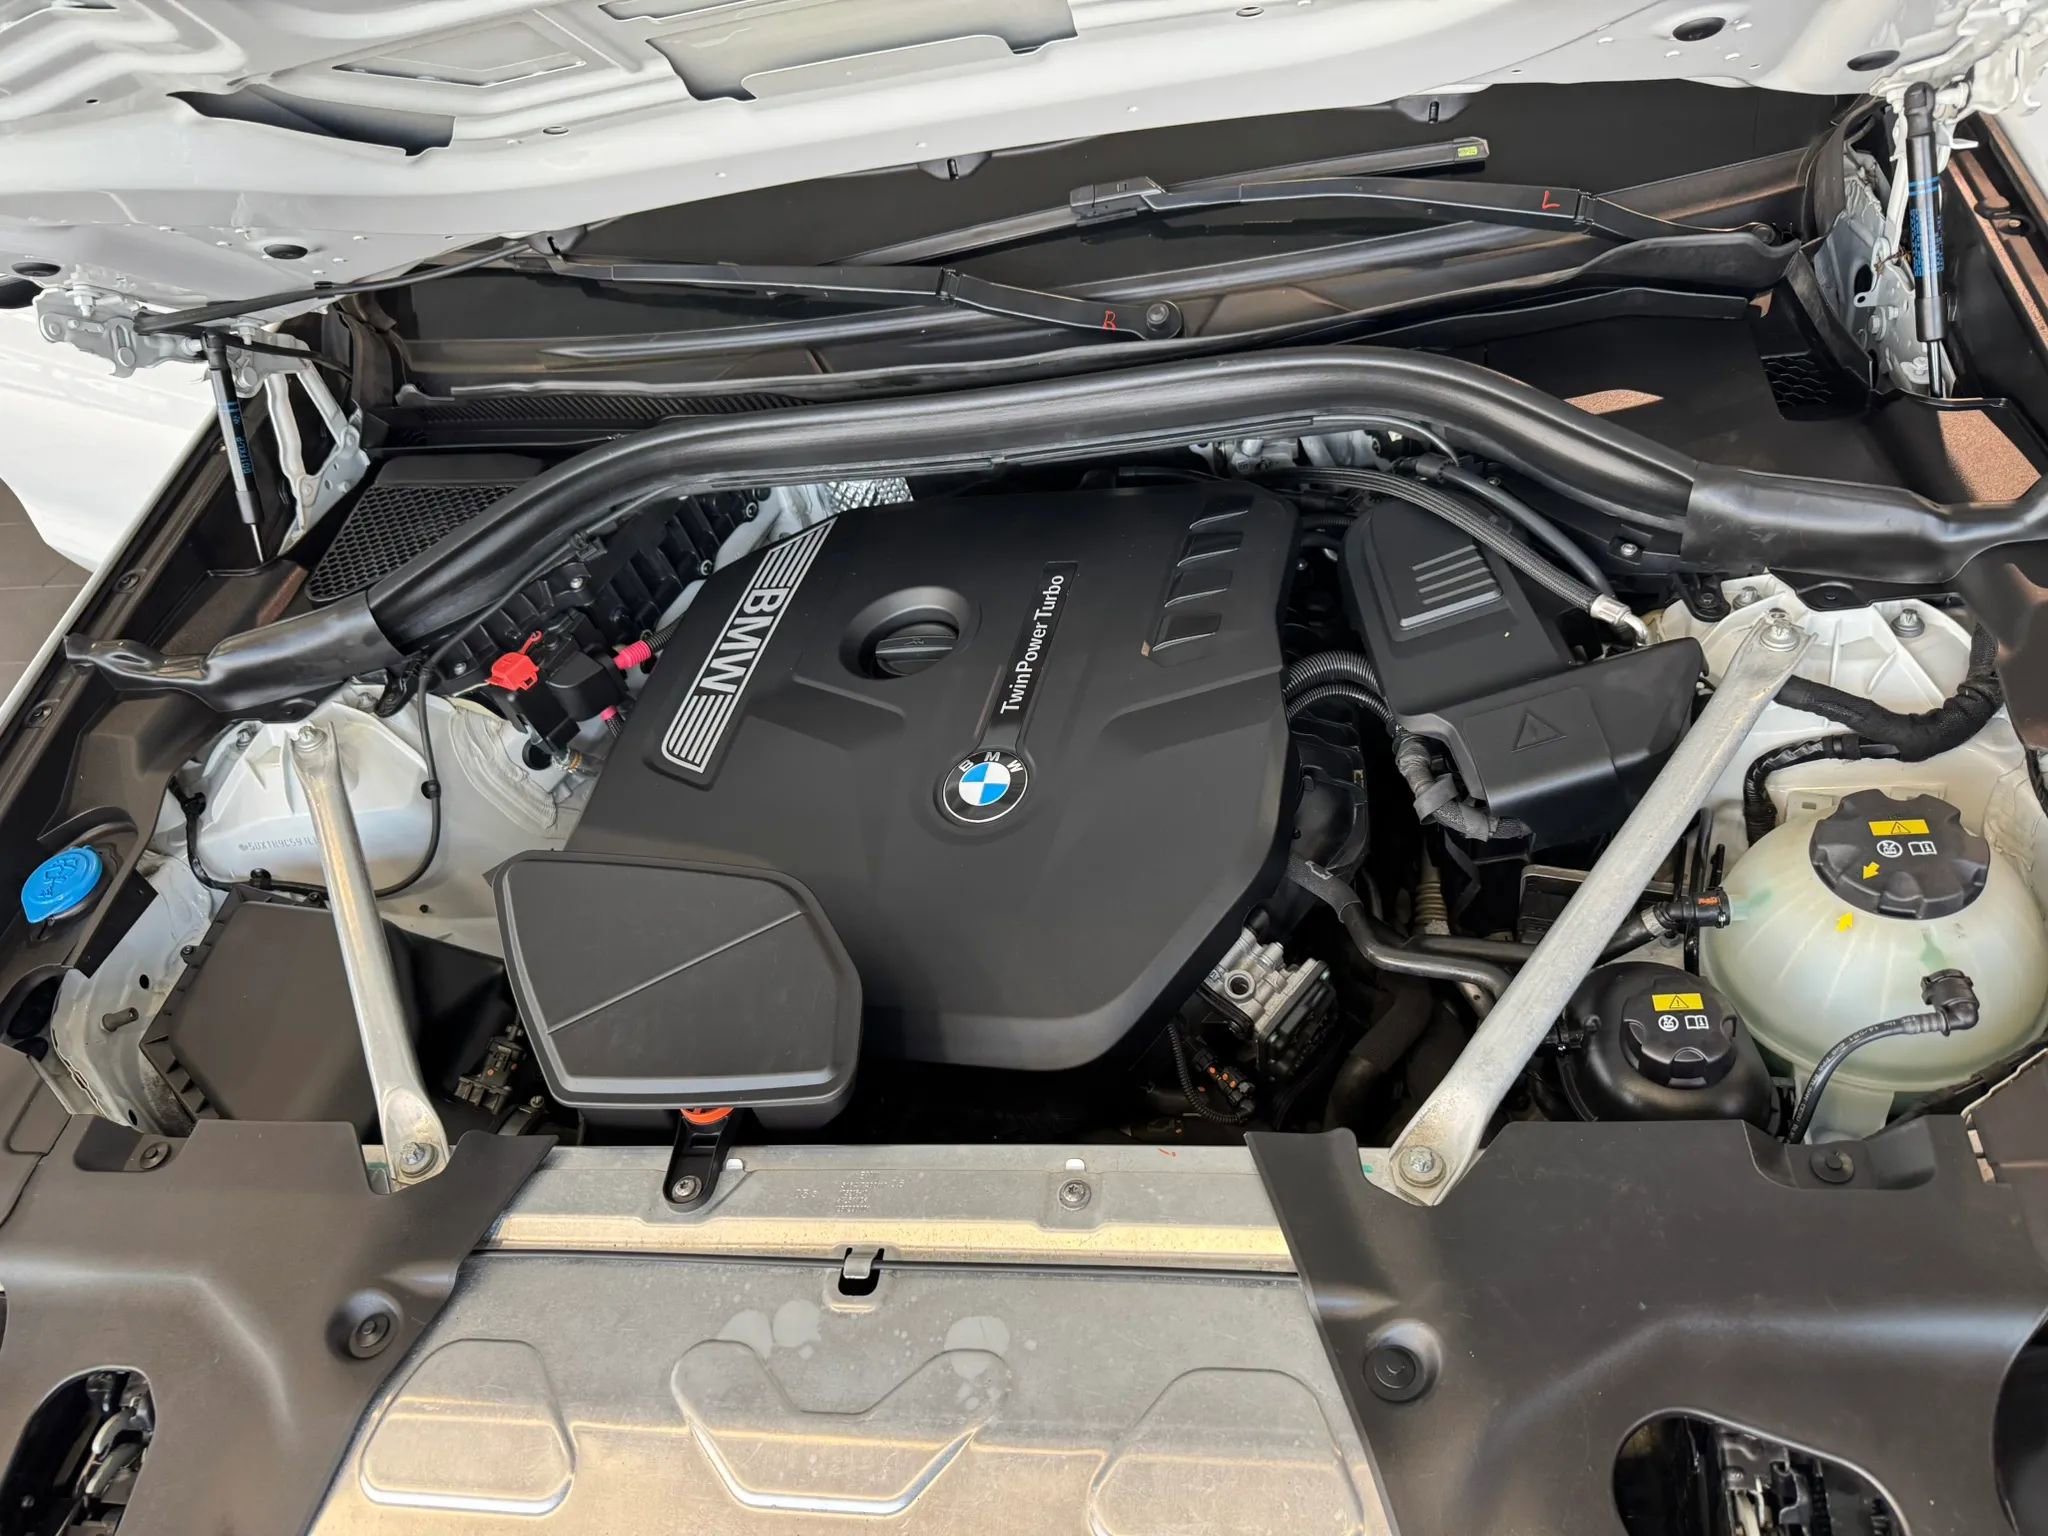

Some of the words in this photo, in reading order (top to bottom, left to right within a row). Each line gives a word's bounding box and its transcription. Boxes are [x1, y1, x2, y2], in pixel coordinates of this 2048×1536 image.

[1542, 190, 1560, 209] L
[699, 588, 790, 693] BMW
[1000, 621, 1048, 714] TwinPower
[1033, 575, 1064, 621] Turbo
[958, 751, 1024, 773] BMW
